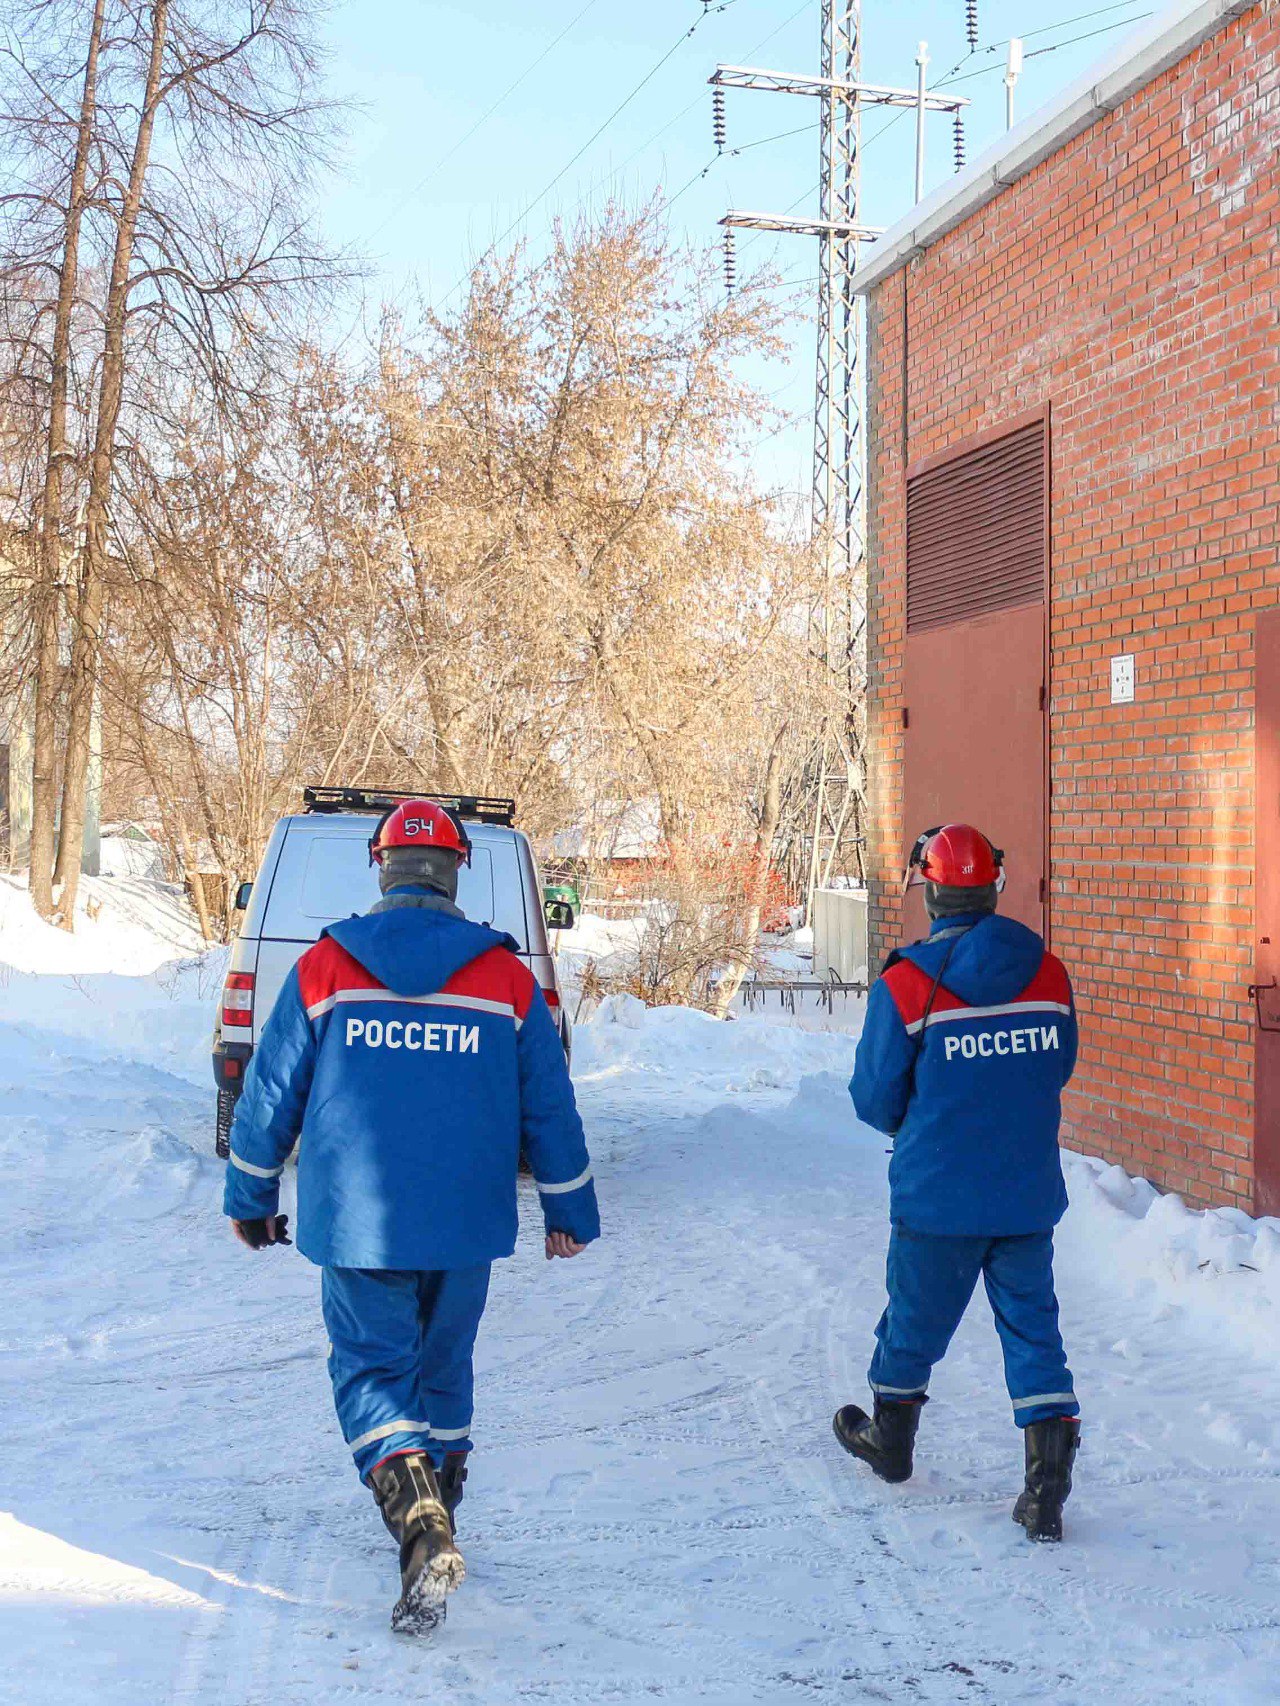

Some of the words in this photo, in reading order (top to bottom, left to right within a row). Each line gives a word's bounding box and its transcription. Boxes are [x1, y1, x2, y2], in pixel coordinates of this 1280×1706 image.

[404, 818, 434, 837] 54
[346, 1018, 480, 1053] РОССЕТИ
[944, 1025, 1060, 1061] РОССЕТИ
